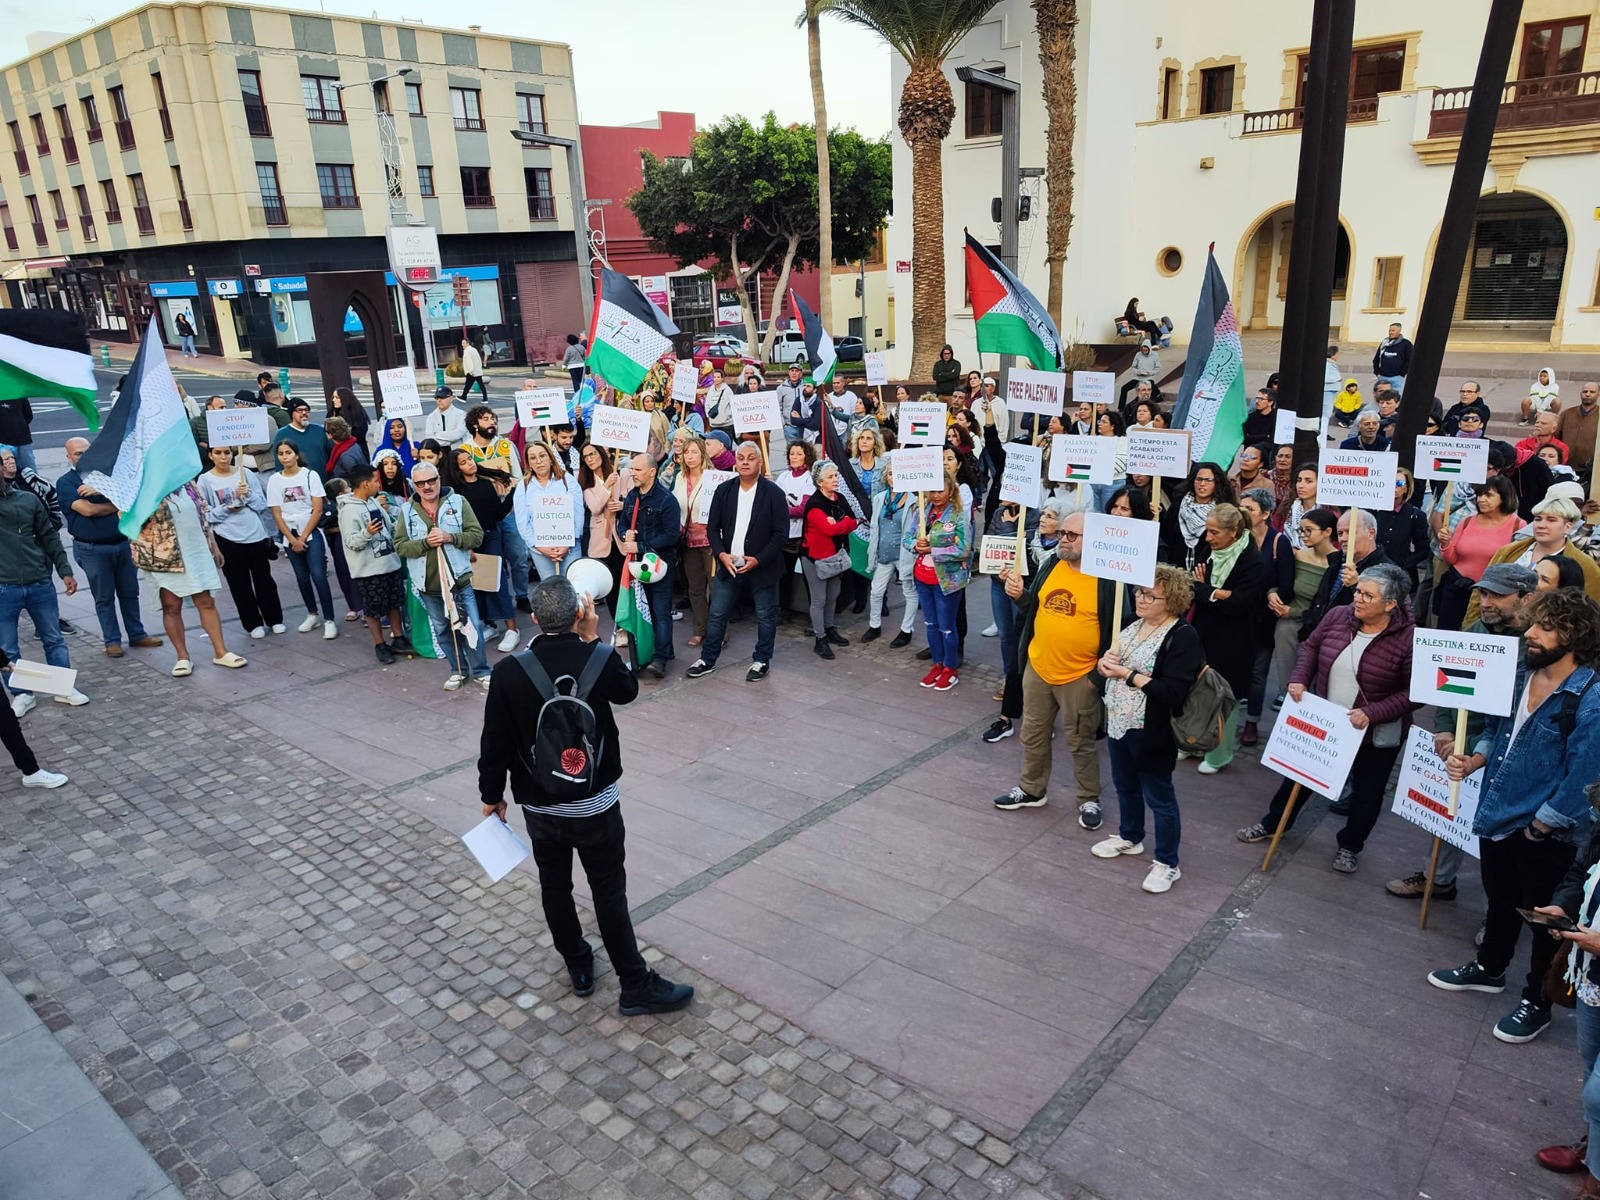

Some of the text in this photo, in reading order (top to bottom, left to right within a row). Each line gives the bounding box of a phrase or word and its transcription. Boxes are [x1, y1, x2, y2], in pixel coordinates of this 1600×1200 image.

[386, 371, 405, 380] PAZ
[384, 384, 414, 393] JUSTICIA
[1008, 381, 1058, 404] FREE PALESTINA
[388, 404, 418, 413] DIGNIDAD
[599, 420, 629, 428] INMEDIATO
[743, 414, 766, 422] GAZA
[602, 428, 630, 439] GAZA
[1326, 466, 1368, 476] COMPLICE
[1333, 478, 1384, 488] COMUNIDAD
[542, 497, 564, 506] PAZ
[1104, 527, 1129, 538] STOP
[1093, 541, 1138, 556] GENOCIDIO
[1096, 558, 1132, 572] EN GAZA
[1416, 638, 1505, 654] PALESTINA: EXISTIR
[1432, 654, 1484, 667] ES RESISTIR
[1298, 709, 1335, 728] SILENCIO
[1288, 716, 1339, 745] COMPLICE DE
[1419, 731, 1428, 740] EL
[1279, 726, 1338, 757] LA COMUNIDAD
[1412, 764, 1449, 788] DE GAZA
[1414, 752, 1435, 768] PARA
[1462, 777, 1479, 788] NTE
[1409, 788, 1469, 828] COMPLIC DE
[1402, 799, 1470, 842] LA COMUNIDAD
